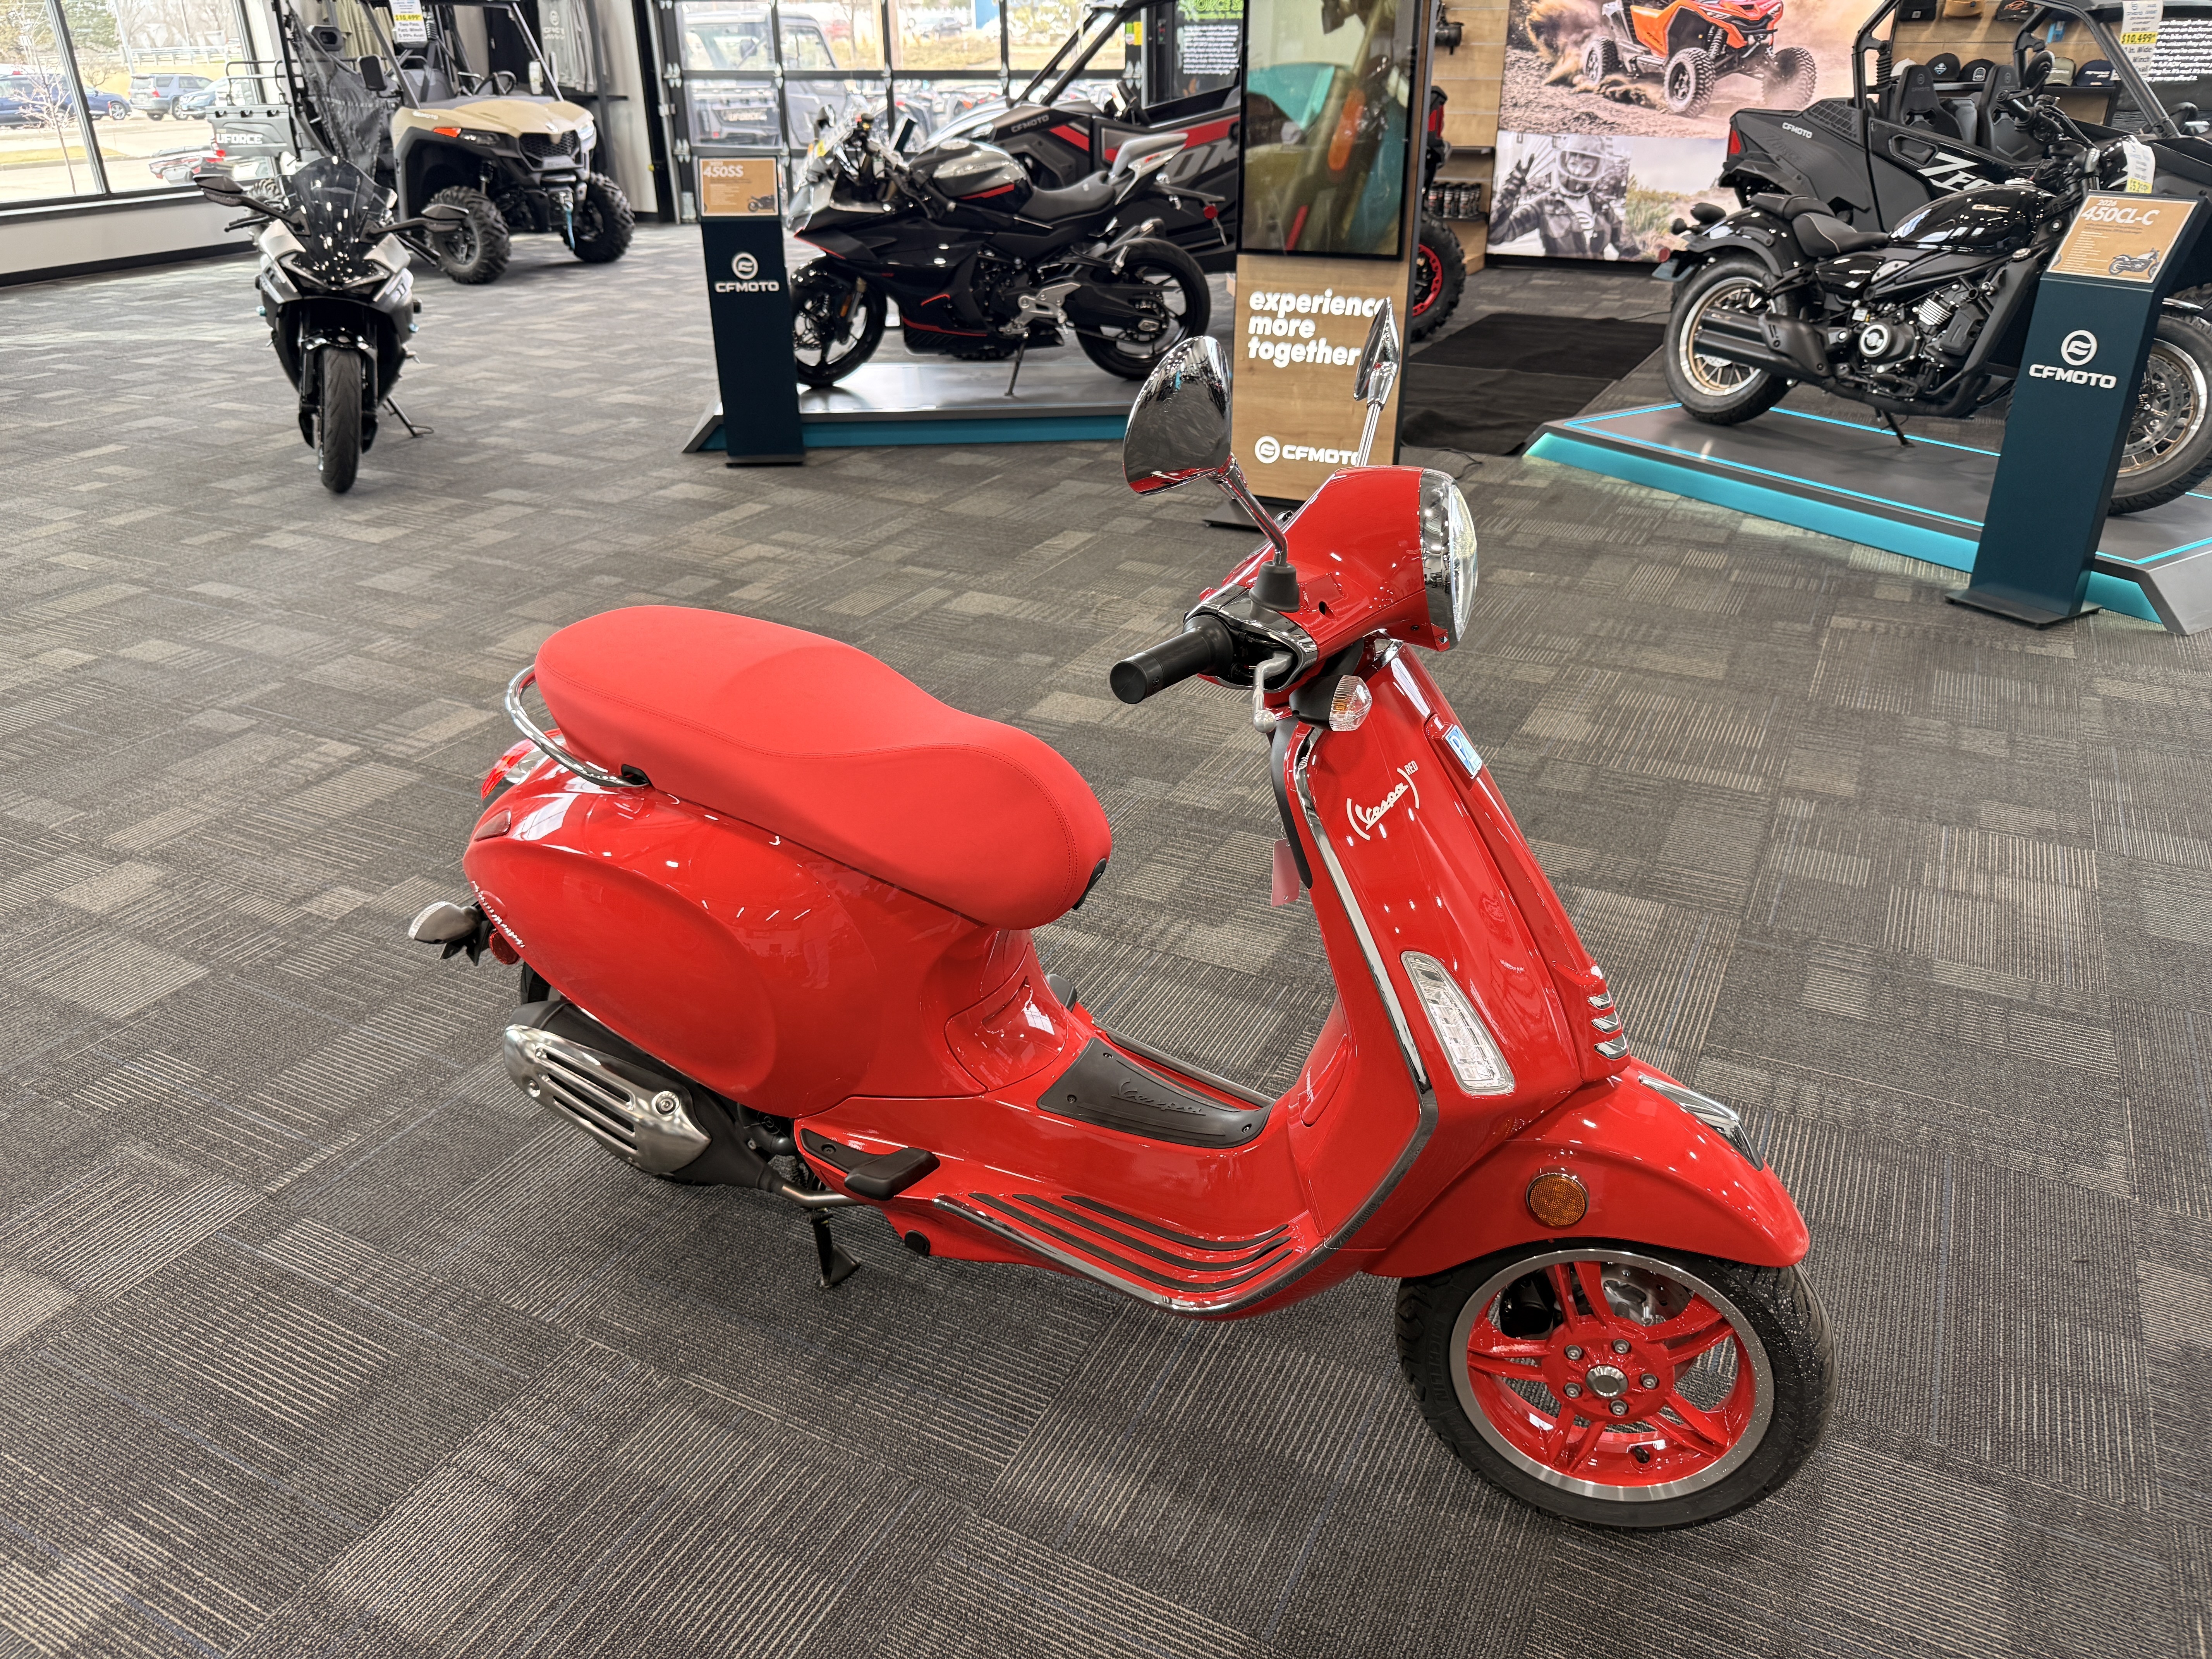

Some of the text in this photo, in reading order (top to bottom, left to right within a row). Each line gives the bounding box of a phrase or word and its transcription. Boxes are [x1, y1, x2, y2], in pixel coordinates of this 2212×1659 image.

[1010, 115, 1049, 133] CFMOTO
[1782, 122, 1813, 139] CFMOTO
[216, 134, 263, 144] UFORCE
[703, 165, 744, 177] 450SS
[2080, 206, 2160, 225] 450CL-C
[714, 281, 780, 292] CFMOTO
[1248, 315, 1316, 338] more
[1248, 336, 1362, 368] together
[2029, 364, 2117, 389] CFMOTO
[1404, 760, 1419, 775] RED
[1111, 1077, 1206, 1116] Vespa
[1428, 1318, 1450, 1400] MICHELIN
